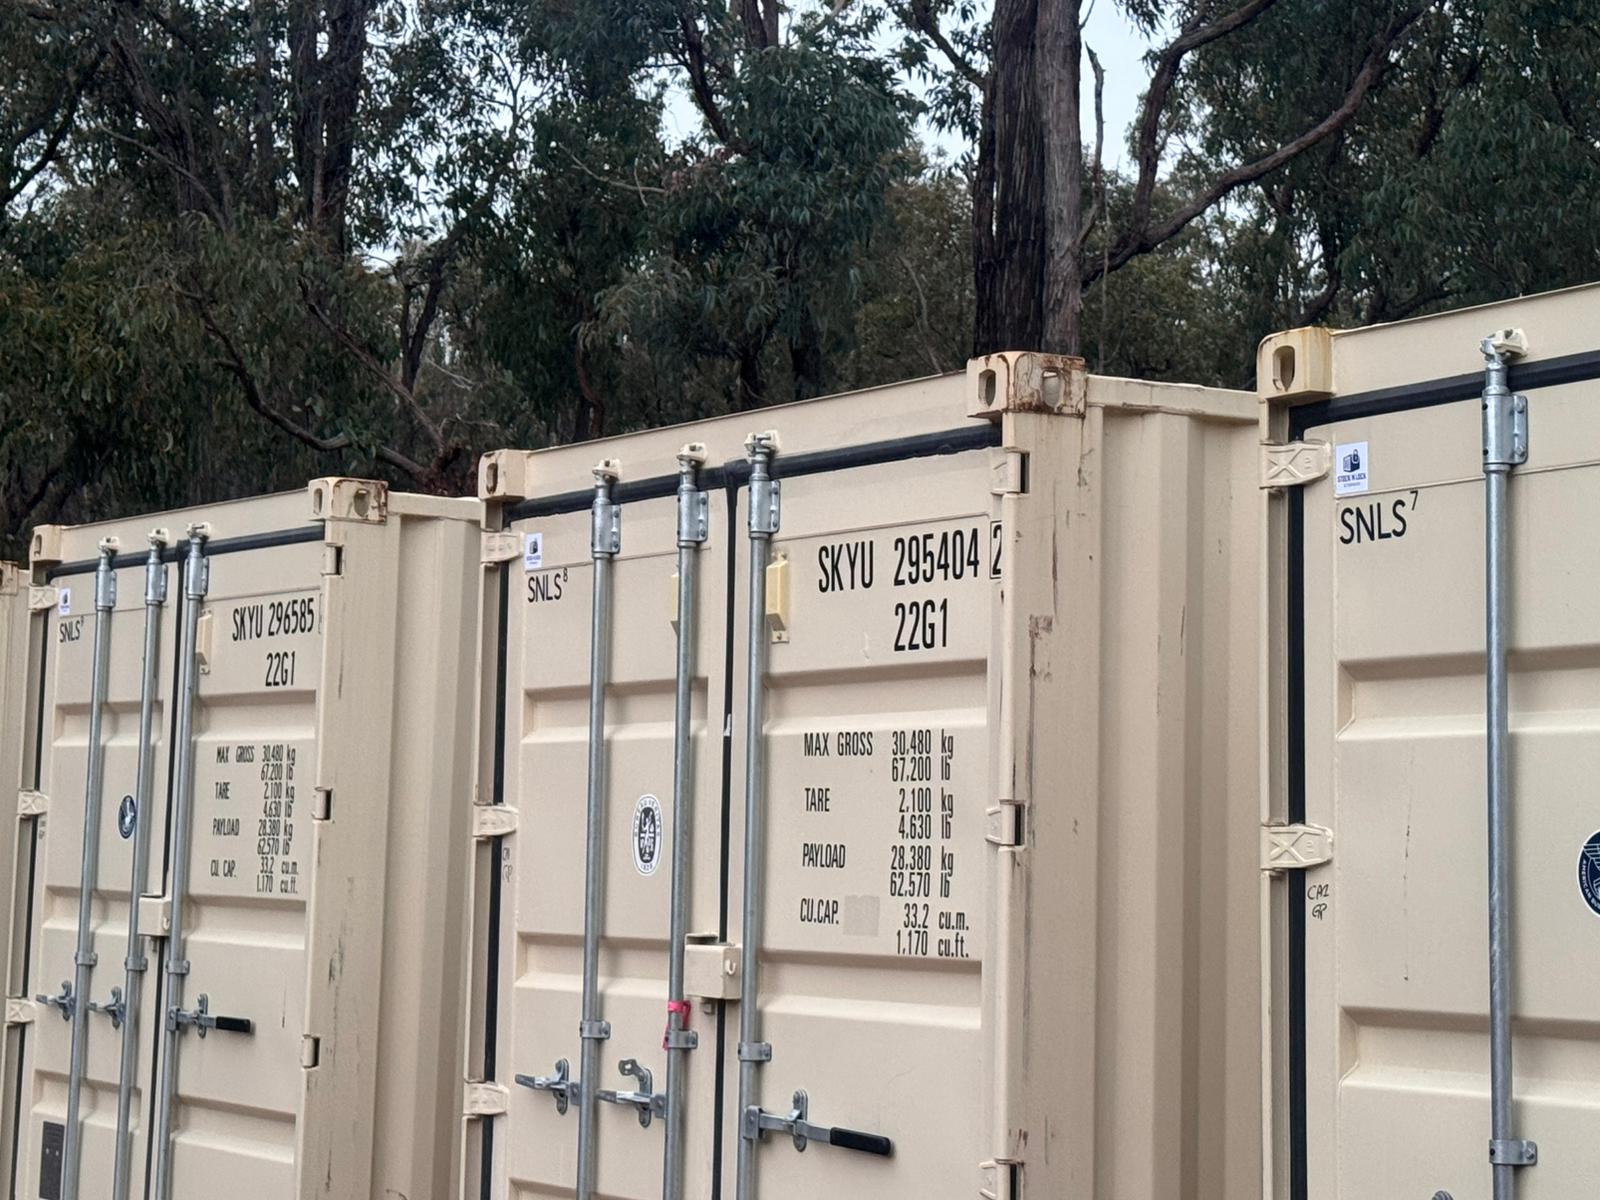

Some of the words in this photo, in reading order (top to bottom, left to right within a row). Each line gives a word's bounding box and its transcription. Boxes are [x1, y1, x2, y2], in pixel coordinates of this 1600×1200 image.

[818, 540, 874, 593] SKYU
[893, 527, 979, 587] 295404
[992, 524, 1002, 576] 2
[232, 604, 264, 642] SKYU
[268, 597, 315, 637] 296585
[893, 598, 949, 652] 22G1
[265, 650, 296, 687] 22G1
[216, 745, 230, 763] MAX
[236, 745, 255, 763] GROSS
[287, 744, 296, 766] kg
[803, 731, 830, 757] MAX
[837, 731, 874, 756] GROSS
[941, 728, 954, 760] kg
[286, 763, 293, 781] lb
[941, 756, 950, 781] lb
[215, 781, 230, 800] TARE
[285, 782, 295, 804] kg
[804, 787, 831, 813] TARE
[941, 787, 954, 819] kg
[285, 800, 293, 818] lb
[212, 817, 240, 836] PAYLOAD
[283, 819, 293, 841] kg
[941, 815, 951, 840] lb
[282, 838, 290, 856] lb
[260, 856, 274, 874] 33.2
[802, 843, 846, 869] PAYLOAD
[941, 845, 954, 878] kg
[940, 872, 950, 898] lb
[800, 898, 840, 925] CU.CAP.
[903, 903, 929, 929] 33.2
[938, 911, 969, 931] cu.m.
[938, 933, 969, 958] cu.ft.
